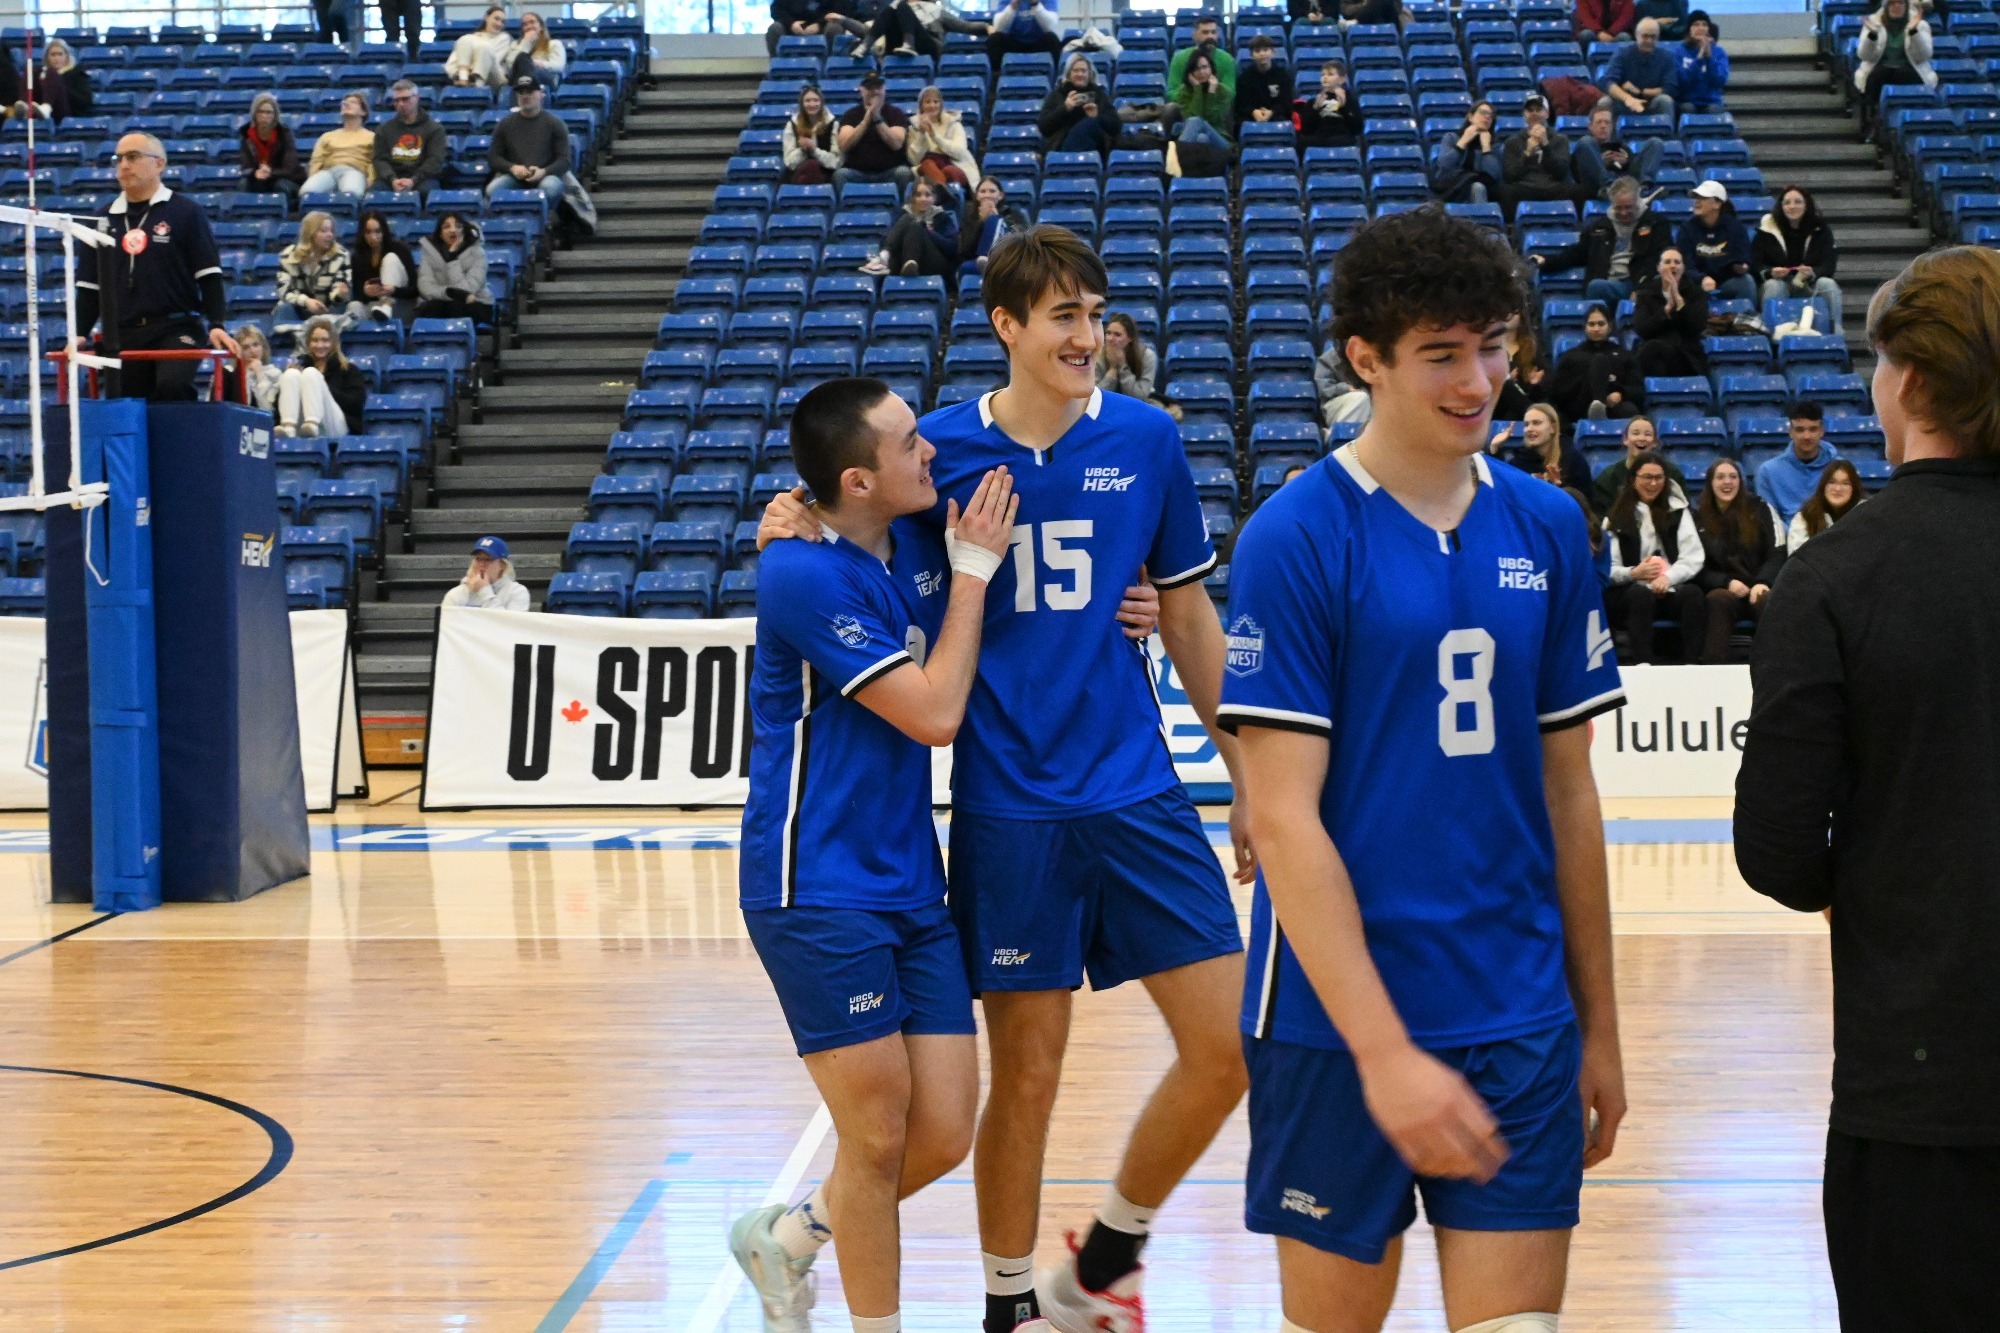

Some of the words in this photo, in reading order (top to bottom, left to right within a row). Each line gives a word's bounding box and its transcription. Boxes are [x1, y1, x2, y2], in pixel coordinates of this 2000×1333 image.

[1084, 467, 1120, 477] UBCO
[1082, 473, 1138, 492] HEAT
[1009, 519, 1094, 613] 15
[913, 570, 930, 584] BCO
[1227, 650, 1258, 667] WEST
[1438, 627, 1496, 758] 8
[507, 643, 556, 781] U
[592, 645, 756, 781] SPO
[991, 952, 1031, 965] HEAT
[994, 948, 1019, 956] UBCO
[849, 991, 874, 1004] UBCO
[849, 993, 884, 1015] HEAT
